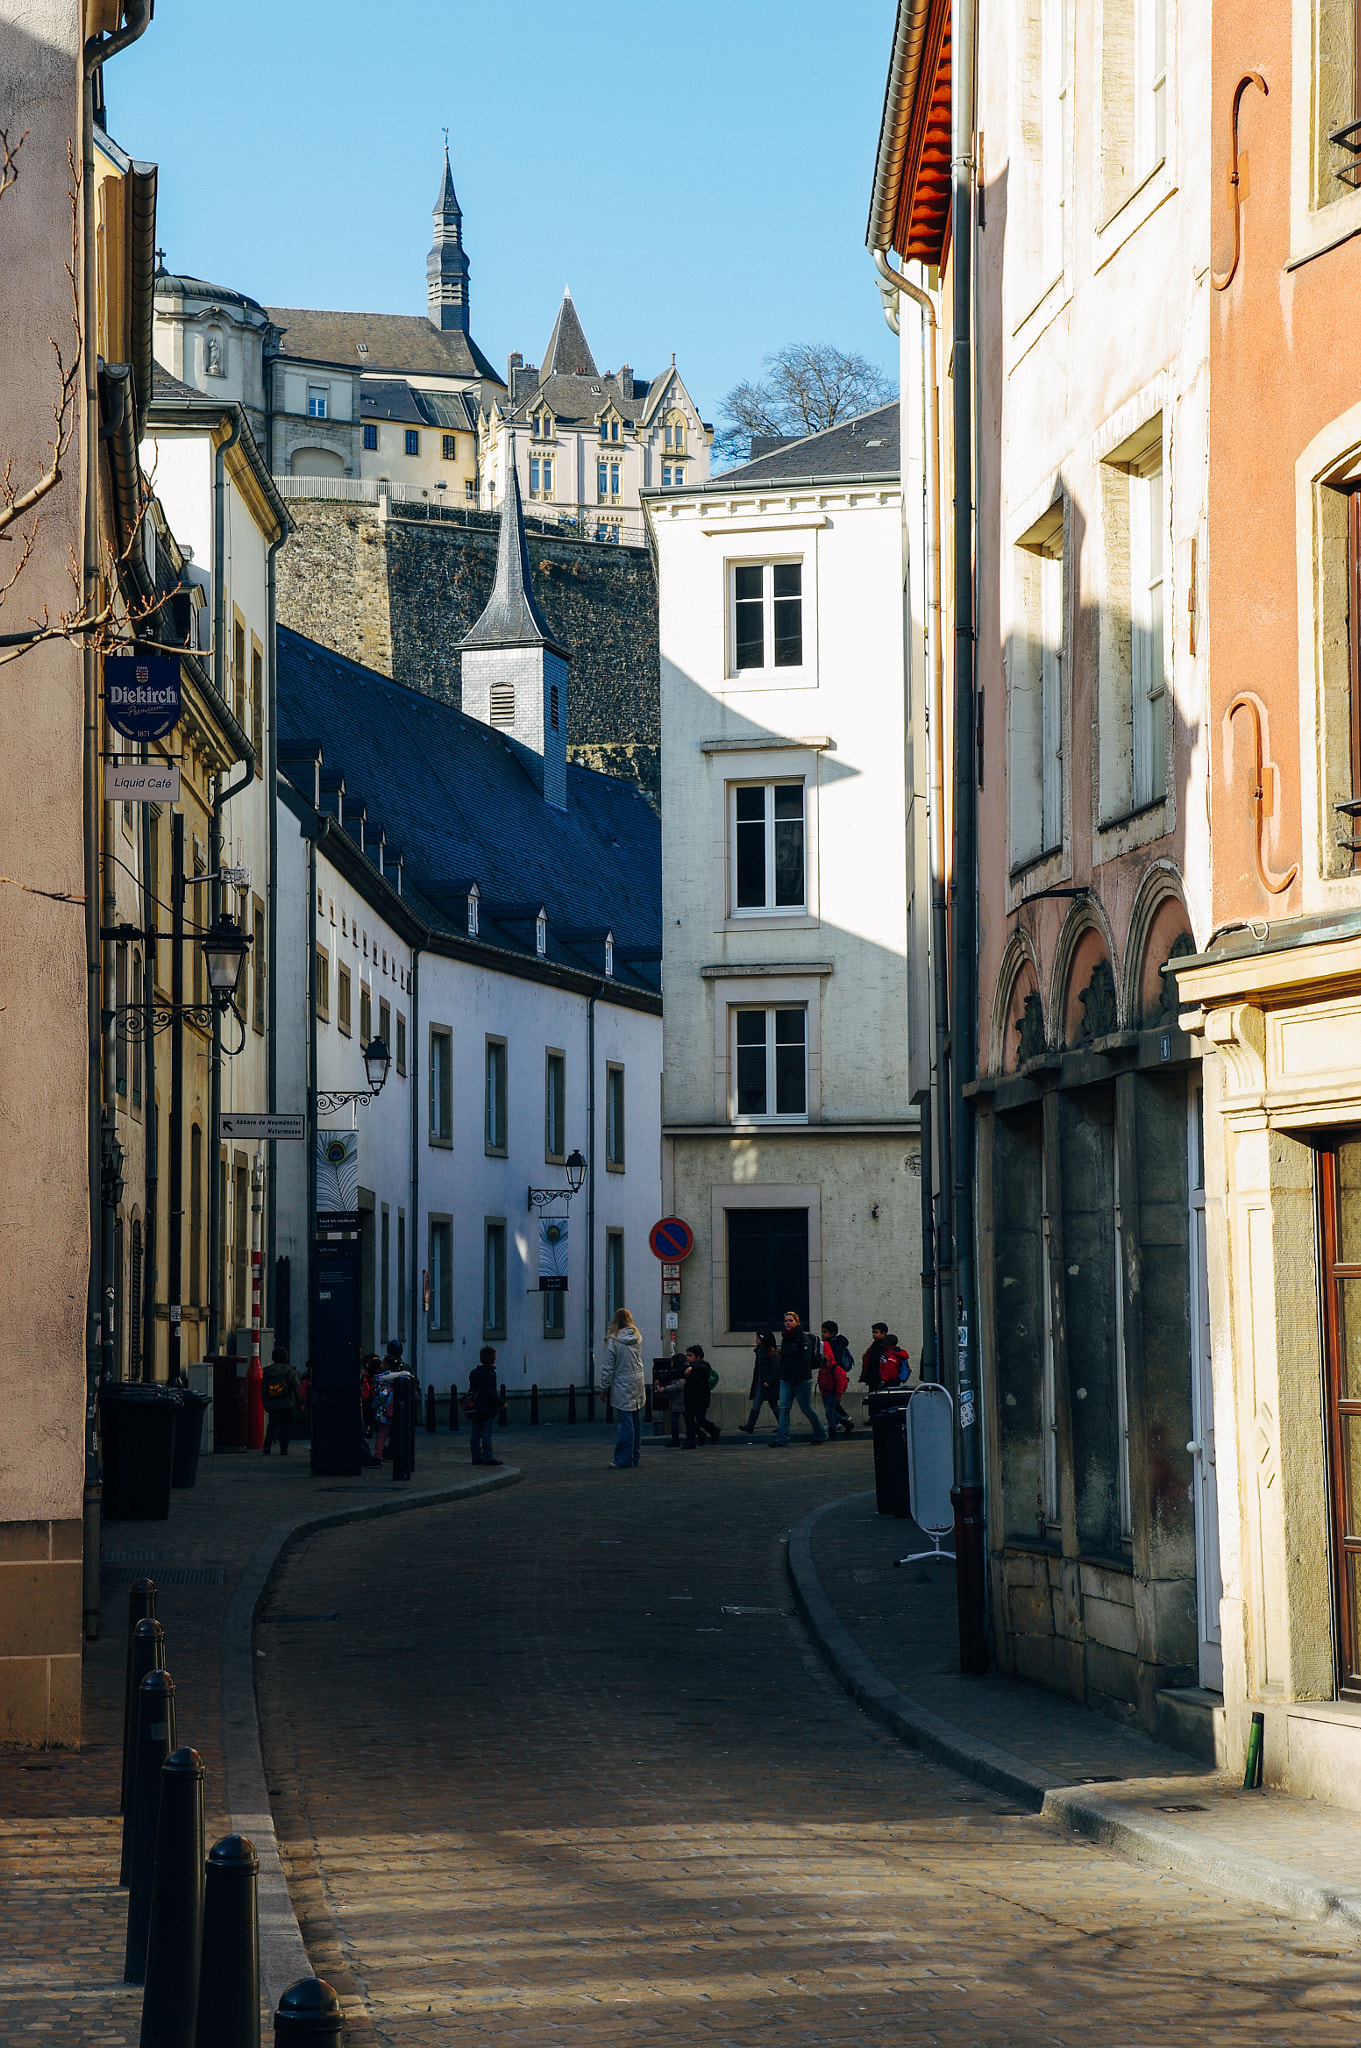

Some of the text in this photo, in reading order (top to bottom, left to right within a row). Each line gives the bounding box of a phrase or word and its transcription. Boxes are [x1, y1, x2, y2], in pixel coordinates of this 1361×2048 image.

[110, 685, 178, 705] Diekirch
[127, 705, 164, 717] Premium
[137, 730, 150, 738] 1871
[114, 778, 172, 789] Liquid Café
